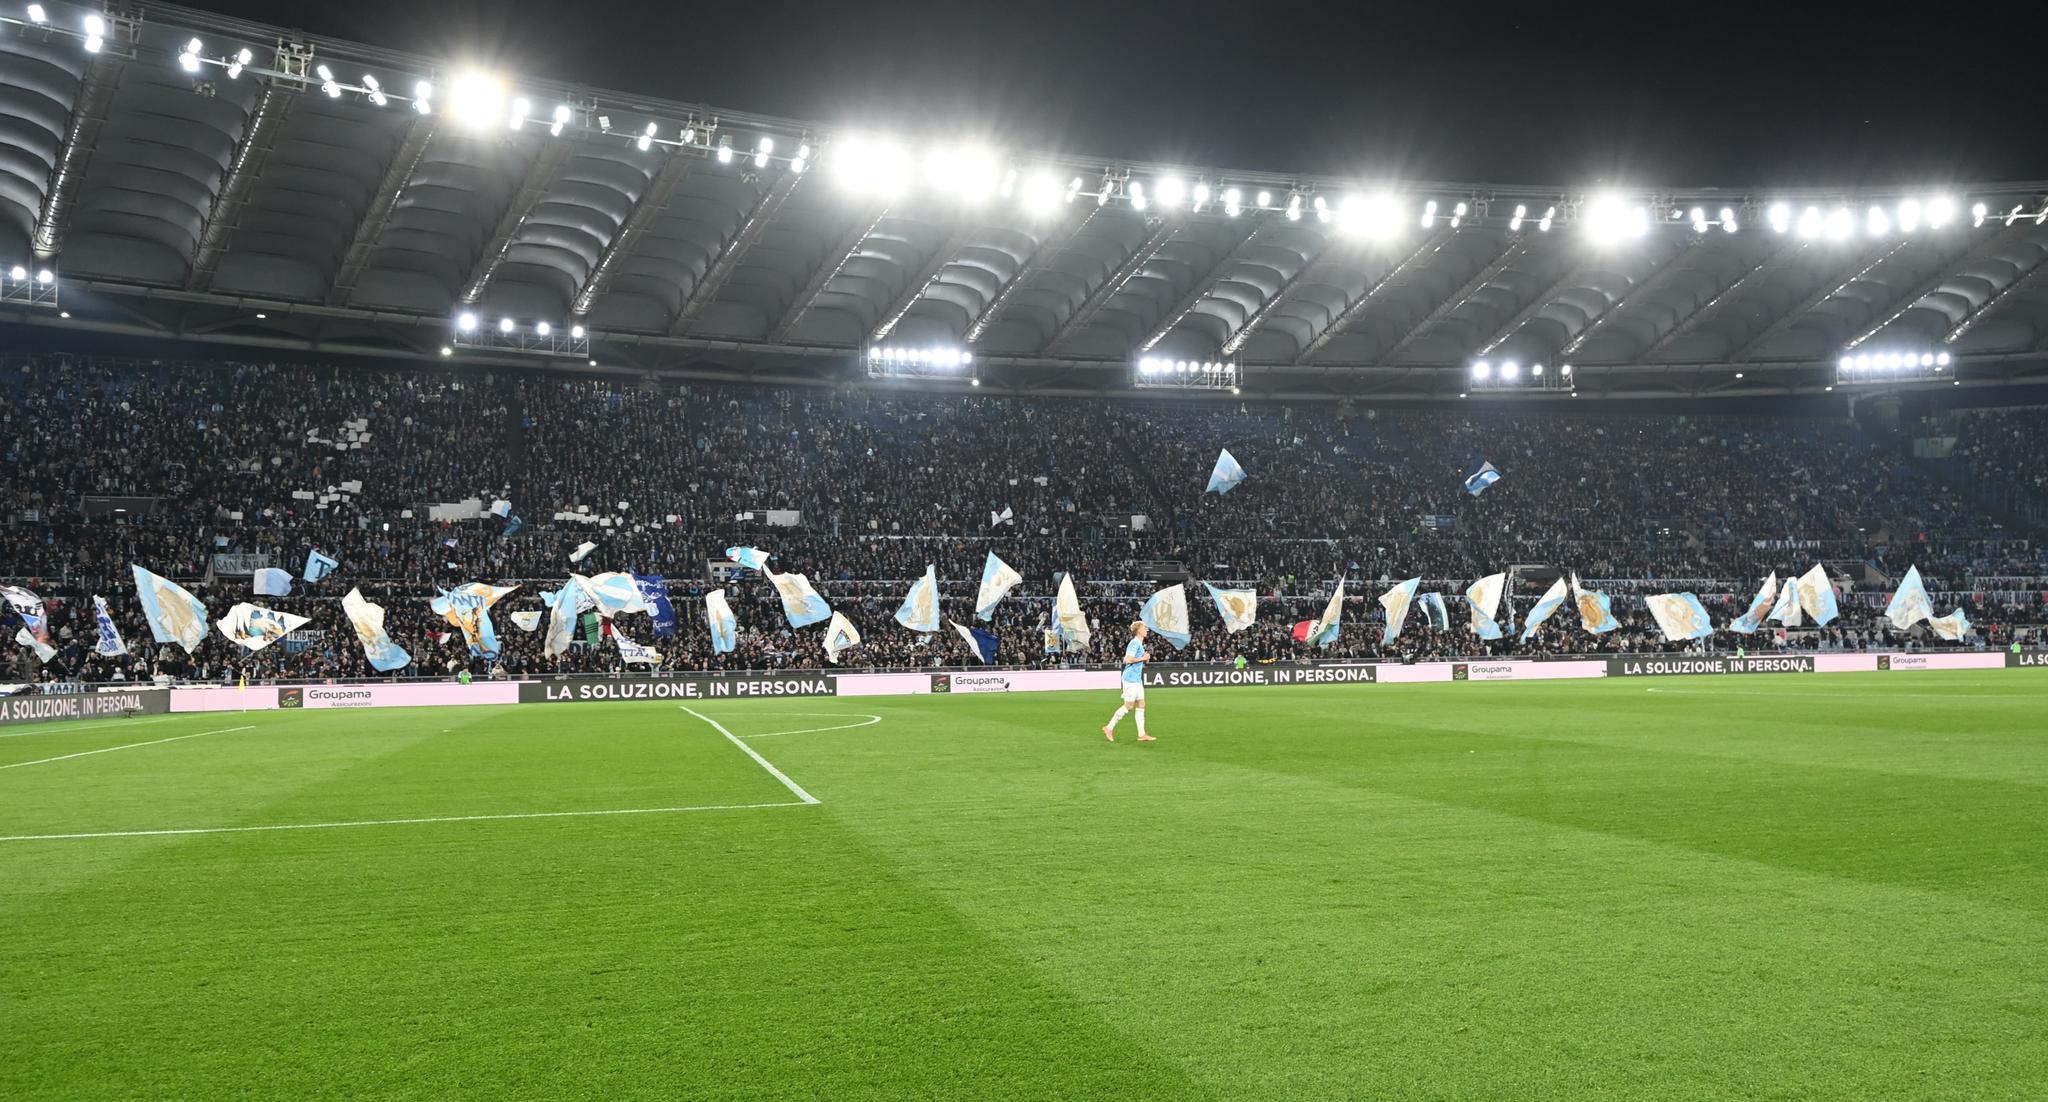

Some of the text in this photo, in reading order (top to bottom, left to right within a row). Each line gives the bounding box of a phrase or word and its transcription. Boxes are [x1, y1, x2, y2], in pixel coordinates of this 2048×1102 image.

[216, 559, 237, 571] SAN
[315, 559, 331, 580] T
[2019, 654, 2034, 665] LA
[1472, 664, 1512, 674] Groupama
[1624, 659, 1812, 674] LA SOLUZIONE, IN PERSONA.
[955, 676, 1005, 686] Groupama
[1143, 668, 1373, 686] LA SOLUZIONE, IN PERSONA.
[309, 690, 372, 700] Groupama
[546, 680, 833, 700] LA SOLUZIONE, IN PERSONA.
[13, 697, 80, 719] SOLUZIONE,
[83, 697, 94, 715] IN
[96, 694, 144, 713] PERSONA.
